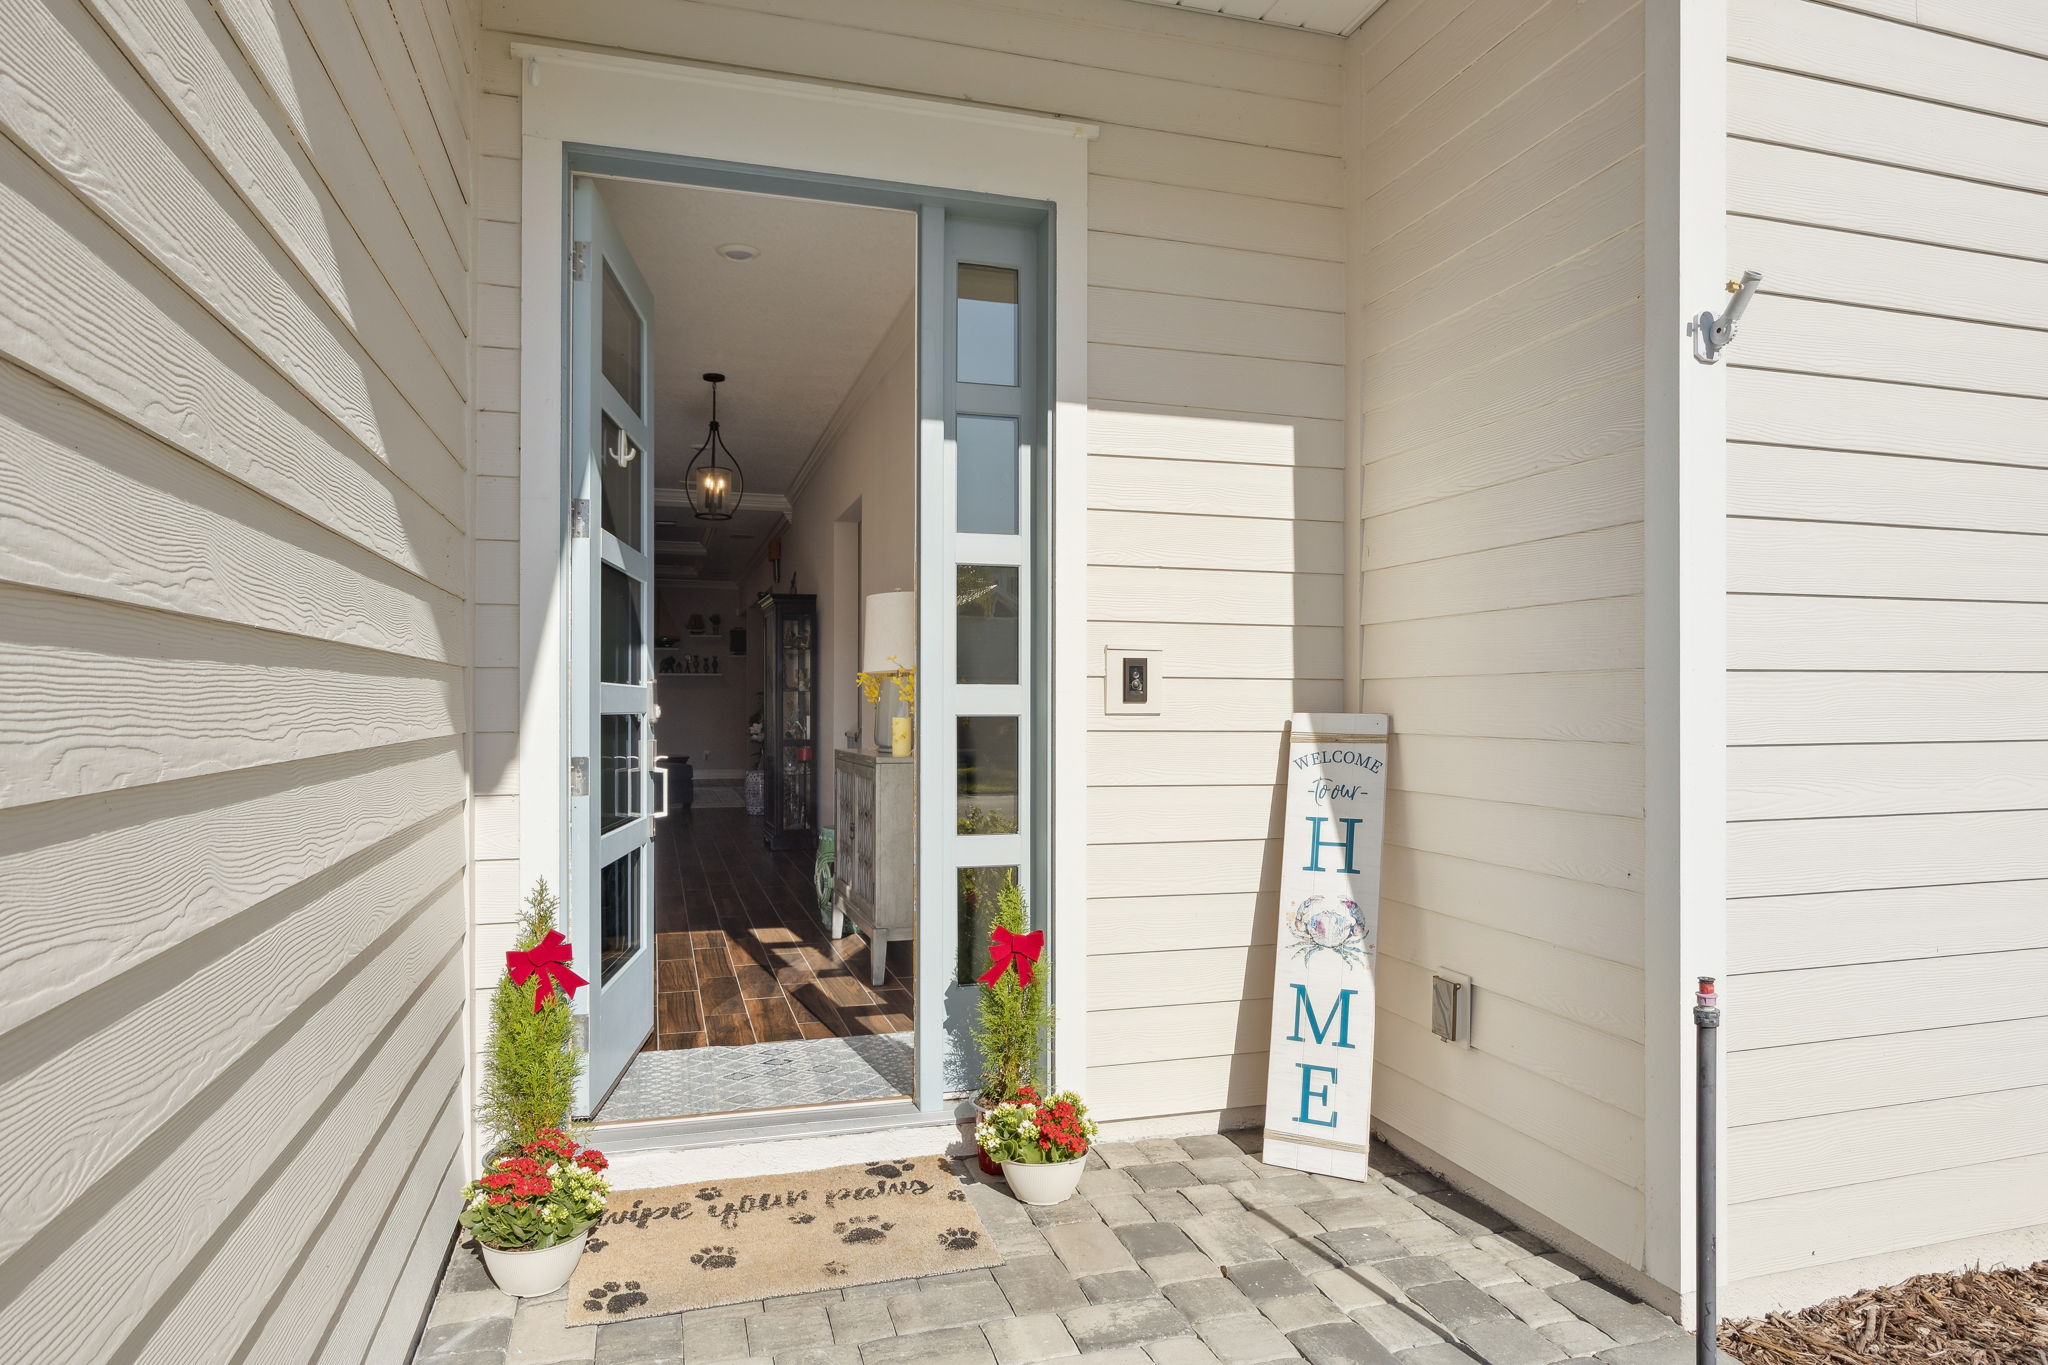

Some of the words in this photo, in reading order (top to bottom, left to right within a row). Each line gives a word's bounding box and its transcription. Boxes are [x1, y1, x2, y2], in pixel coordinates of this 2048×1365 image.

[1293, 750, 1384, 775] WELCOME
[597, 1199, 694, 1230] wipe
[707, 1189, 808, 1231] your
[825, 1179, 935, 1209] paws
